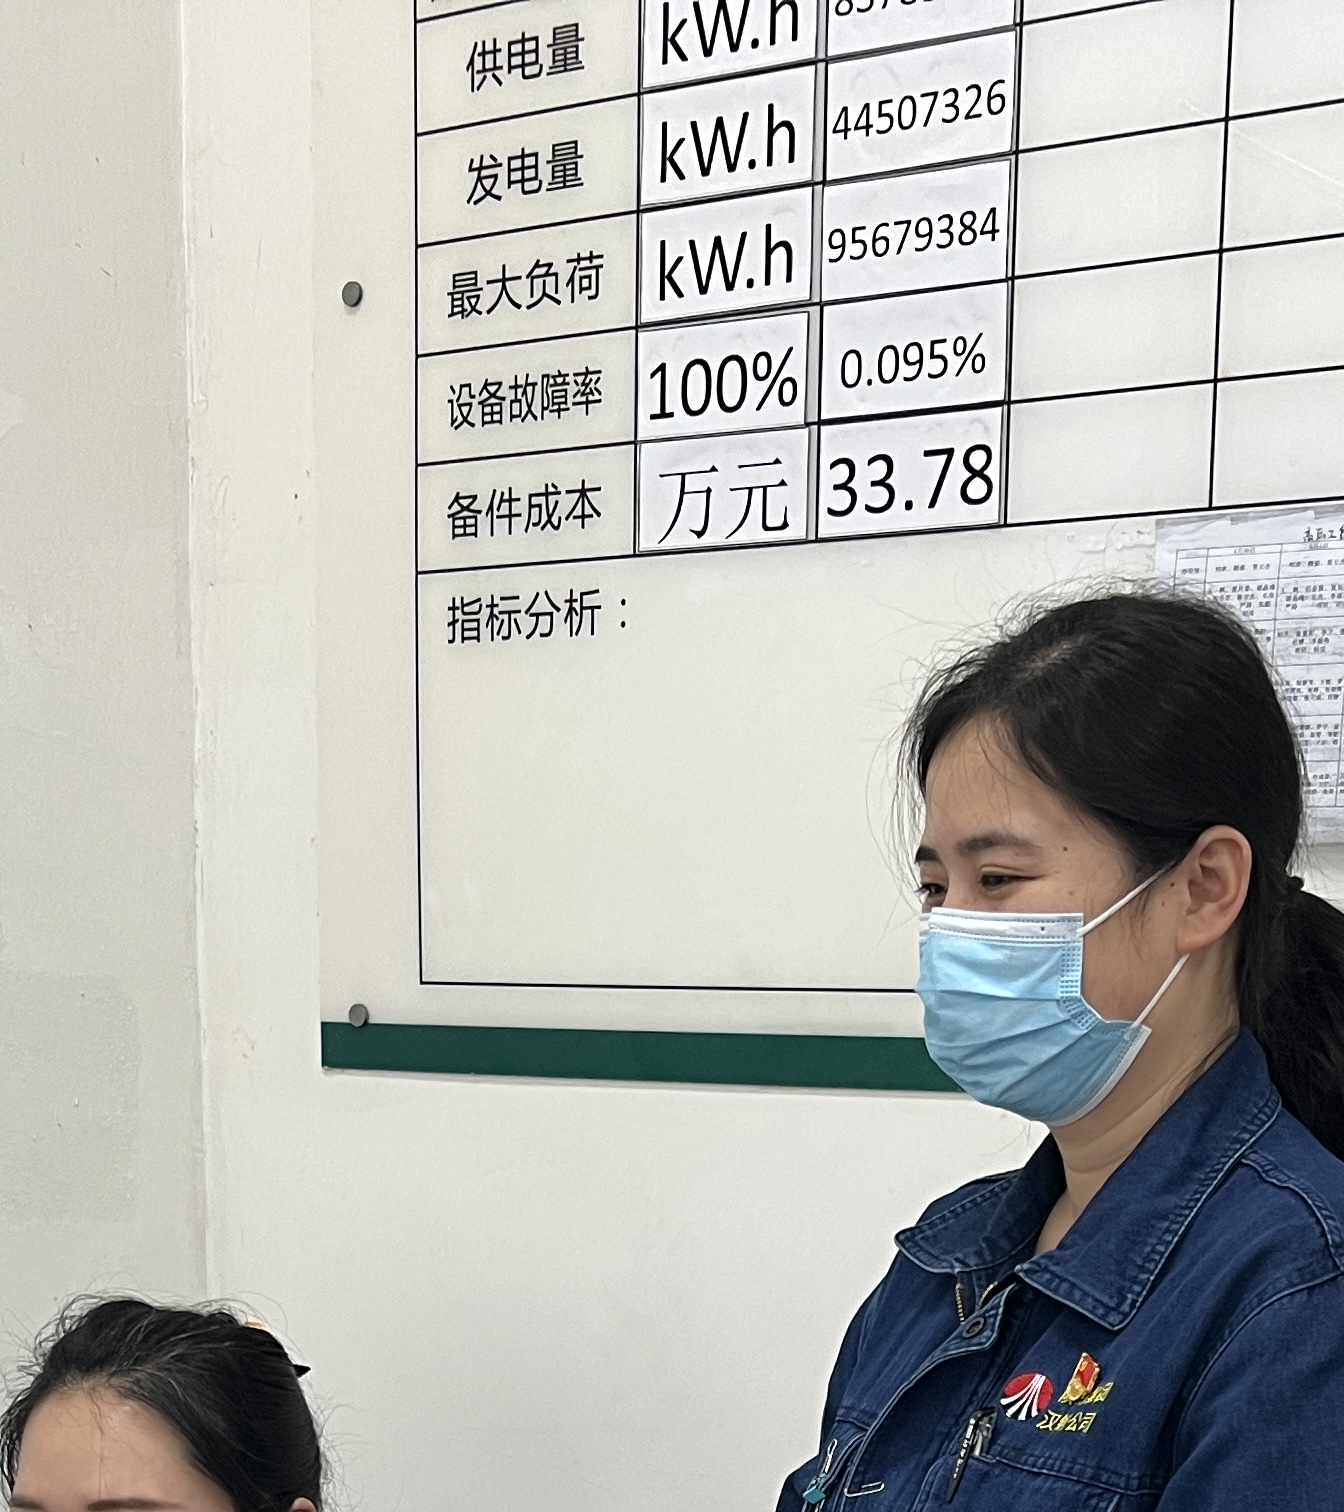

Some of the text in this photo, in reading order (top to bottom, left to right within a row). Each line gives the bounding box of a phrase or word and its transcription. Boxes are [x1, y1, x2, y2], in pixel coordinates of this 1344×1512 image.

[467, 23, 585, 92] 供电量
[659, 103, 796, 184] kW.h
[832, 79, 1007, 142] 44507326
[467, 140, 585, 206] 发电量
[659, 223, 794, 301] kW.h
[827, 207, 1000, 264] 95679384
[447, 251, 604, 320] 最大负荷
[648, 346, 798, 421] 100%
[840, 332, 986, 390] 0.095%
[447, 366, 603, 431] 设备故障率
[447, 480, 602, 540] 备件成本
[658, 457, 789, 543] 万元
[827, 444, 994, 518] 33.78
[447, 588, 629, 645] 指标分析：
